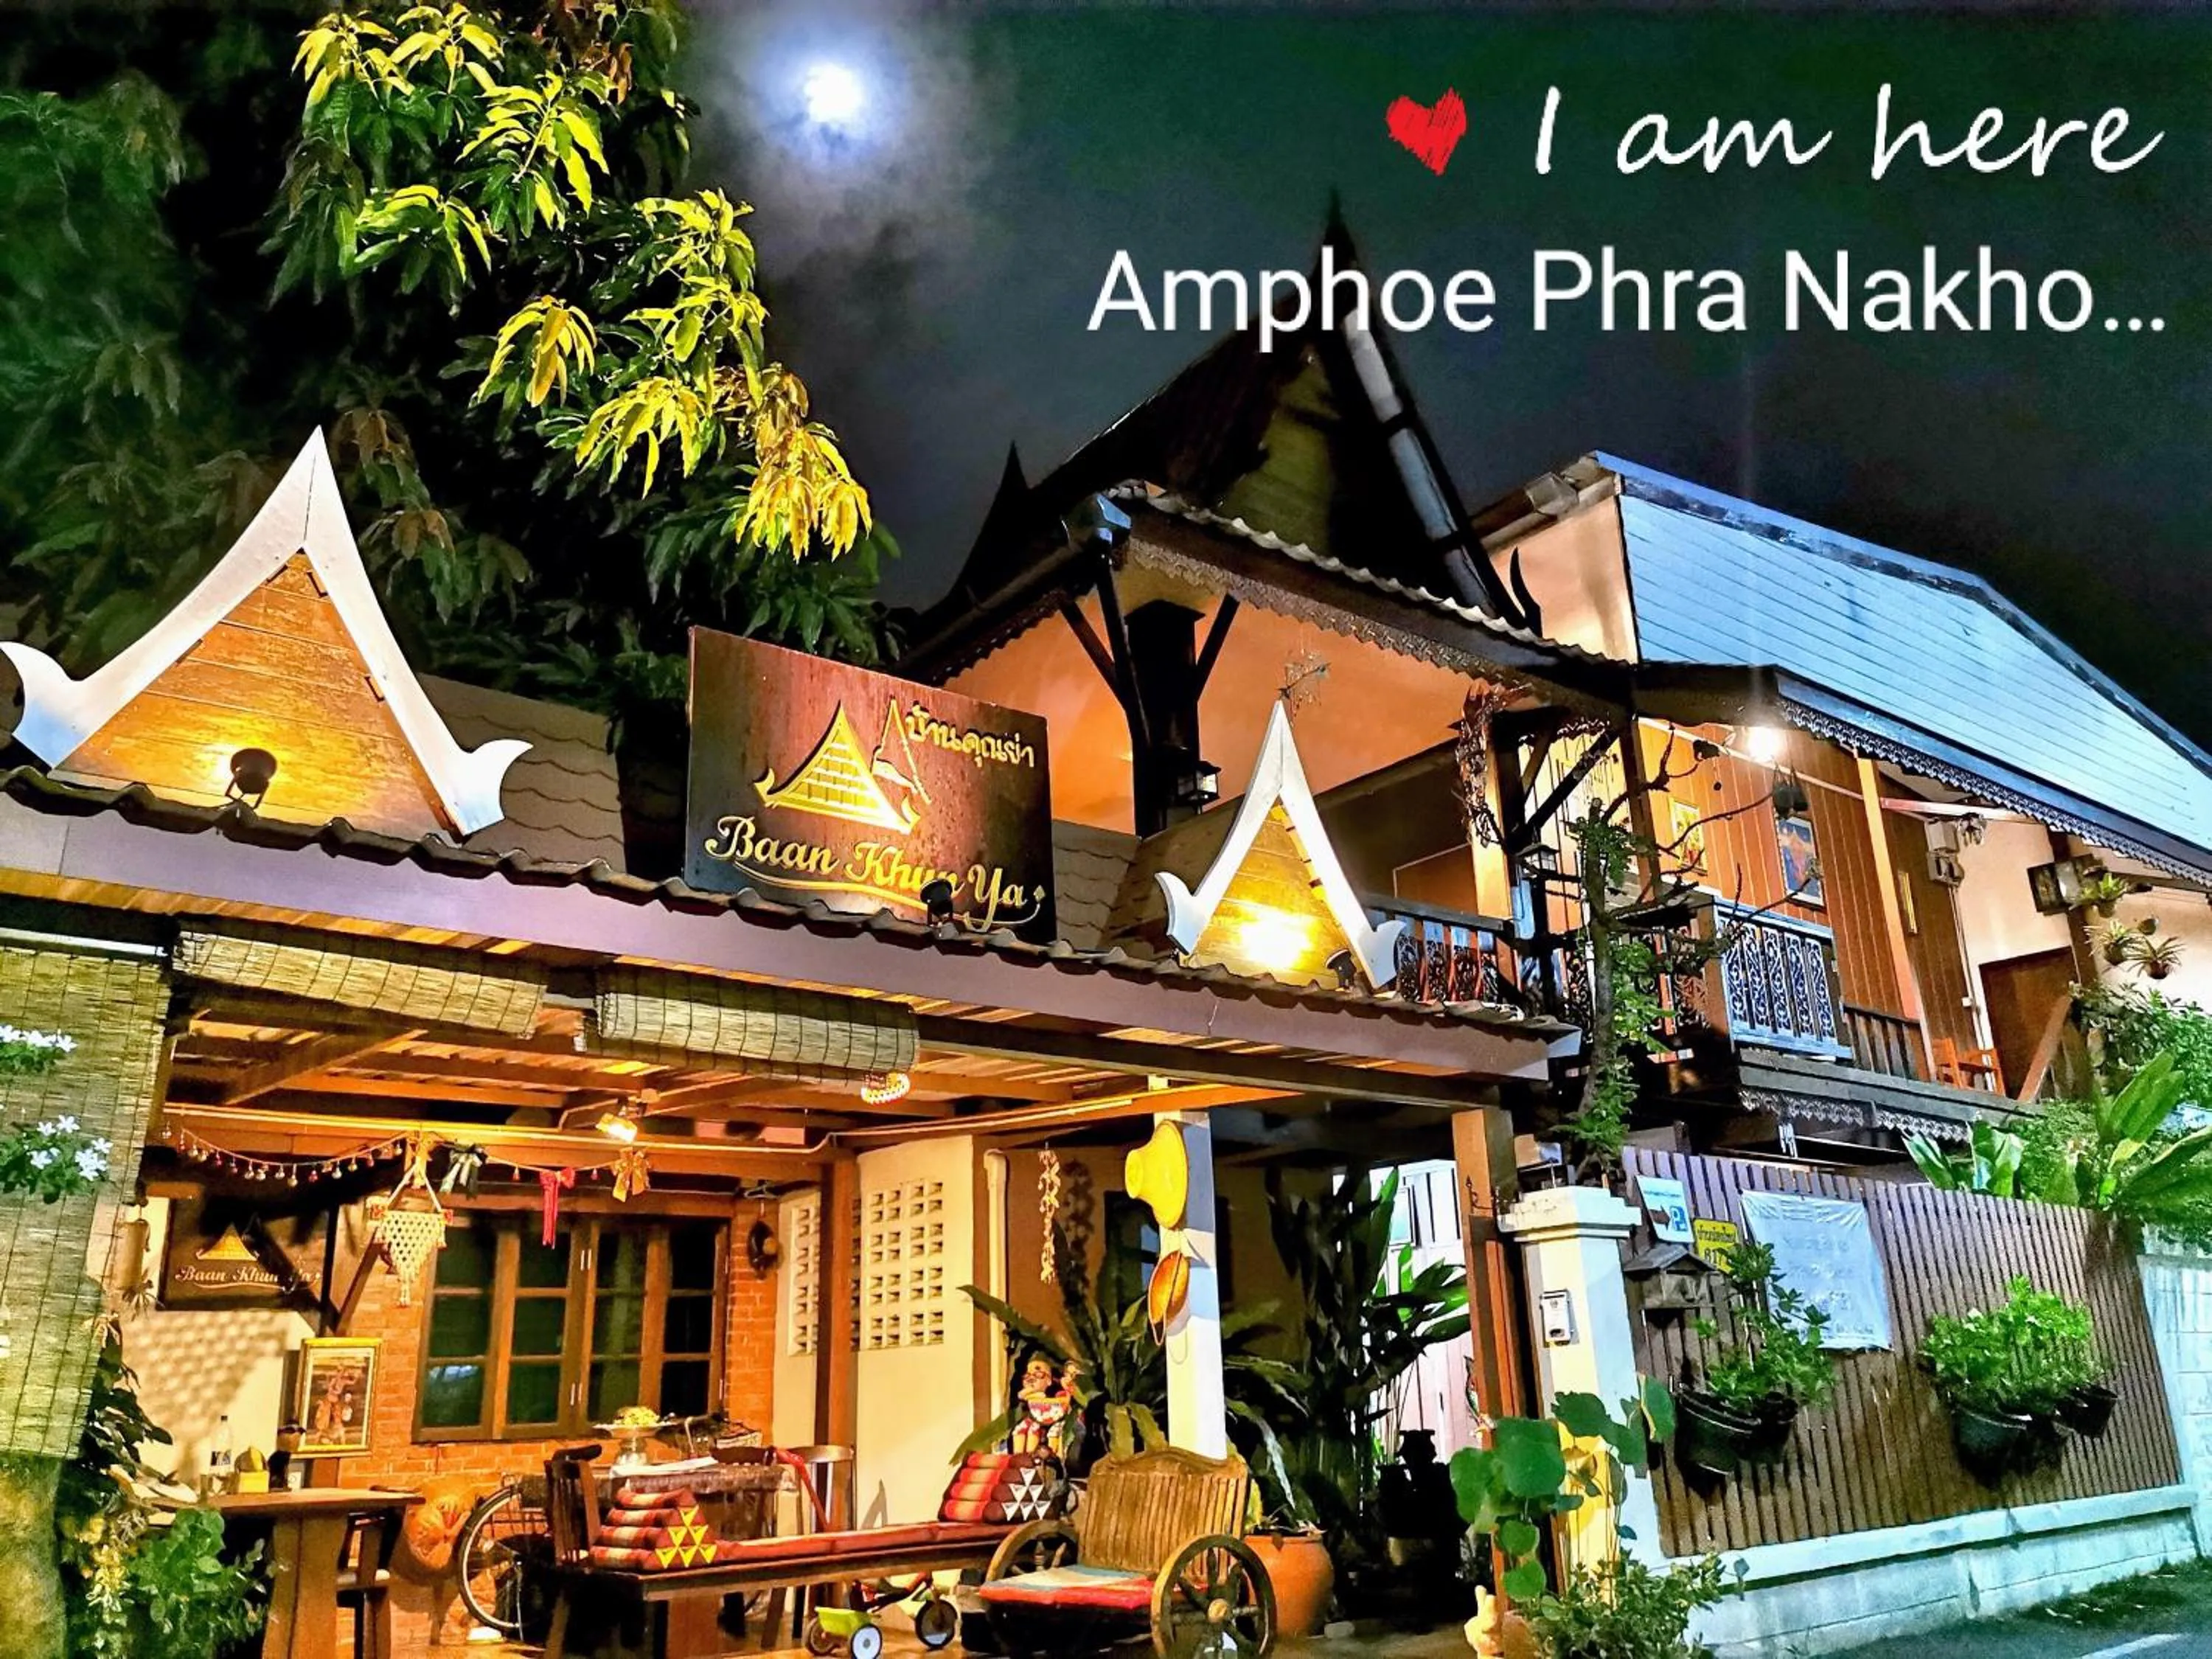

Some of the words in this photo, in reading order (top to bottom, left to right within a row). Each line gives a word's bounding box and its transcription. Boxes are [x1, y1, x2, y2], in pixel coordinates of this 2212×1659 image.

[905, 702, 1034, 768] บ้านคุณย่า
[705, 815, 840, 874] Baan
[844, 841, 965, 898] Khun
[963, 863, 1029, 932] Ya
[175, 1265, 226, 1282] Baan
